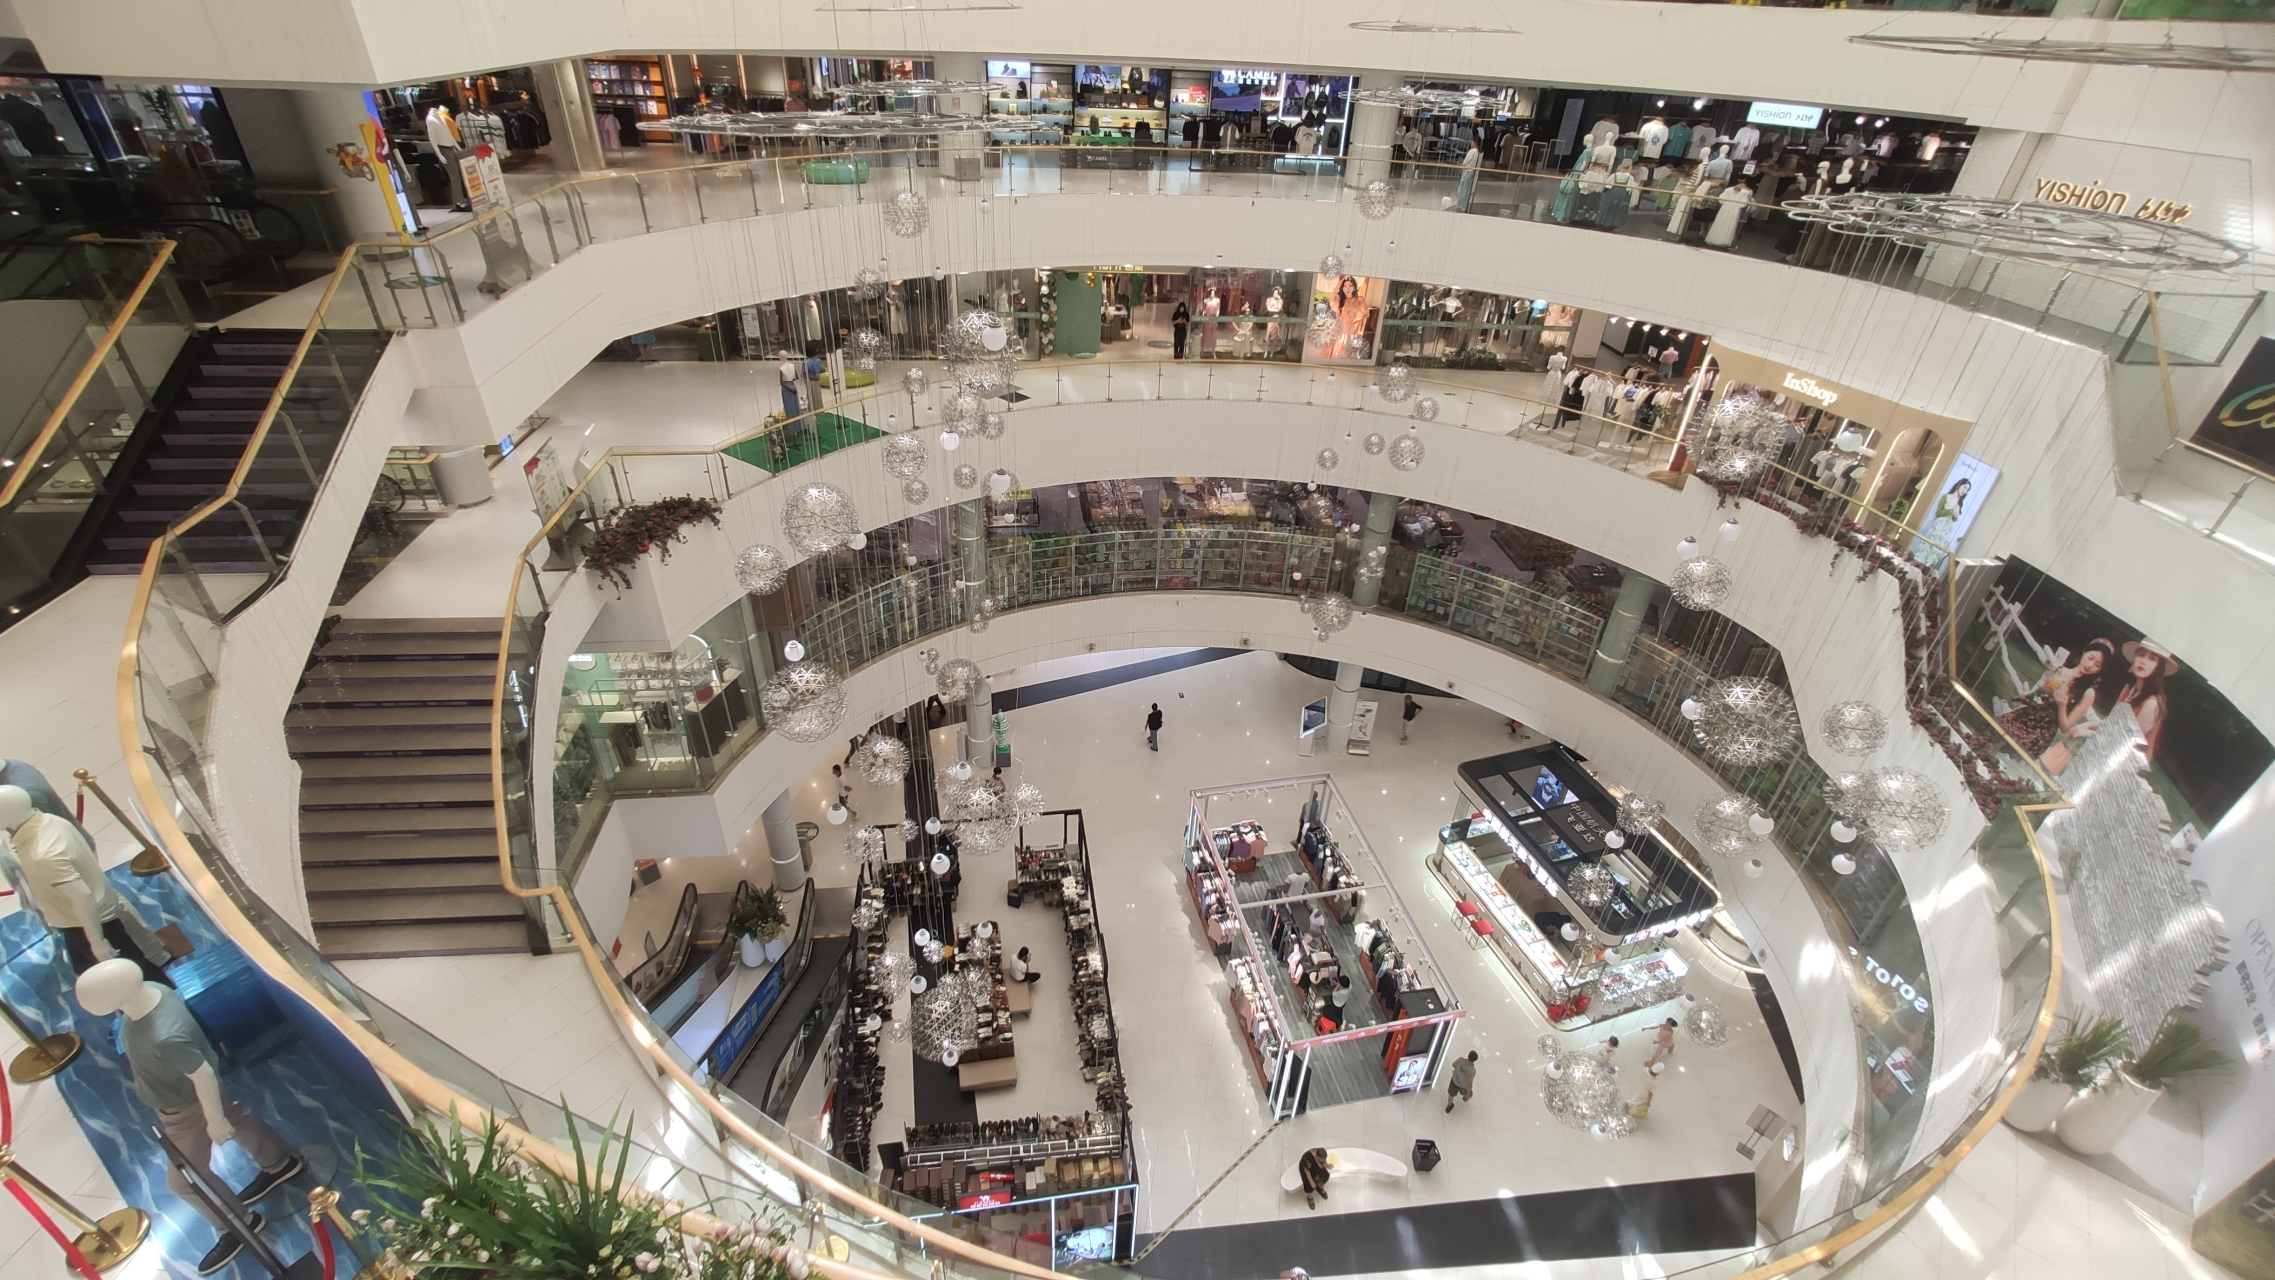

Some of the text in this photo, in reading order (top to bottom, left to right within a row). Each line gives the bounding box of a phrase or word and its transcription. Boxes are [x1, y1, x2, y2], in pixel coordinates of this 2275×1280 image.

[1238, 69, 1277, 80] CAMEL
[1783, 372, 1838, 406] InShop
[1567, 812, 1596, 843] 飞亚达
[1570, 803, 1607, 842] 中国航天
